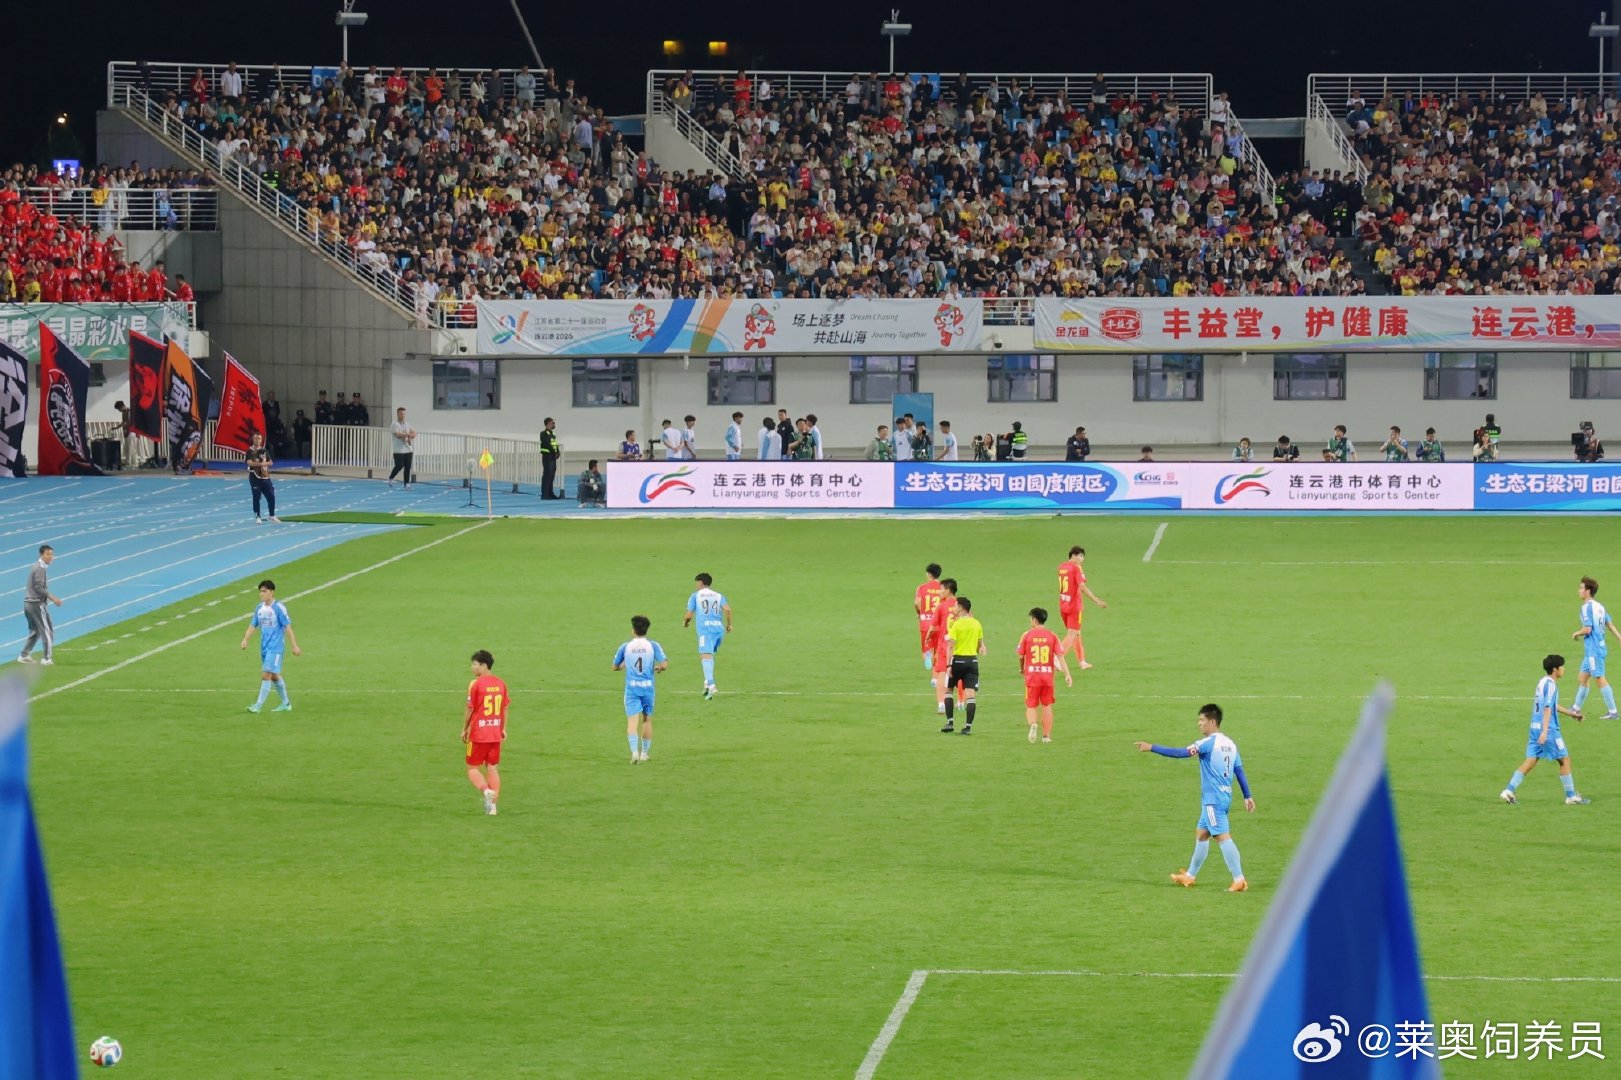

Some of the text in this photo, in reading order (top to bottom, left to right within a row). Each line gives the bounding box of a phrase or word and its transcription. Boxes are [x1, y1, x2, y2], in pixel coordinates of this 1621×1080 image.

[792, 313, 846, 327] 场上逐梦
[850, 313, 899, 322] Dream Chasing
[1471, 305, 1595, 339] 连云港，
[556, 332, 574, 341] 2026
[813, 330, 868, 345] 共赴山海
[871, 331, 928, 340] Journey Together
[1056, 326, 1089, 338] 金龙鱼
[713, 473, 863, 487] 连云港市体育中心
[1289, 474, 1442, 489] 连云港市体育中心
[712, 488, 862, 499] Lianyungang Sports Center
[1288, 490, 1441, 501] Lianyungang Sports Center
[701, 599, 720, 615] 94
[1030, 645, 1050, 664] 38
[483, 694, 503, 717] 50
